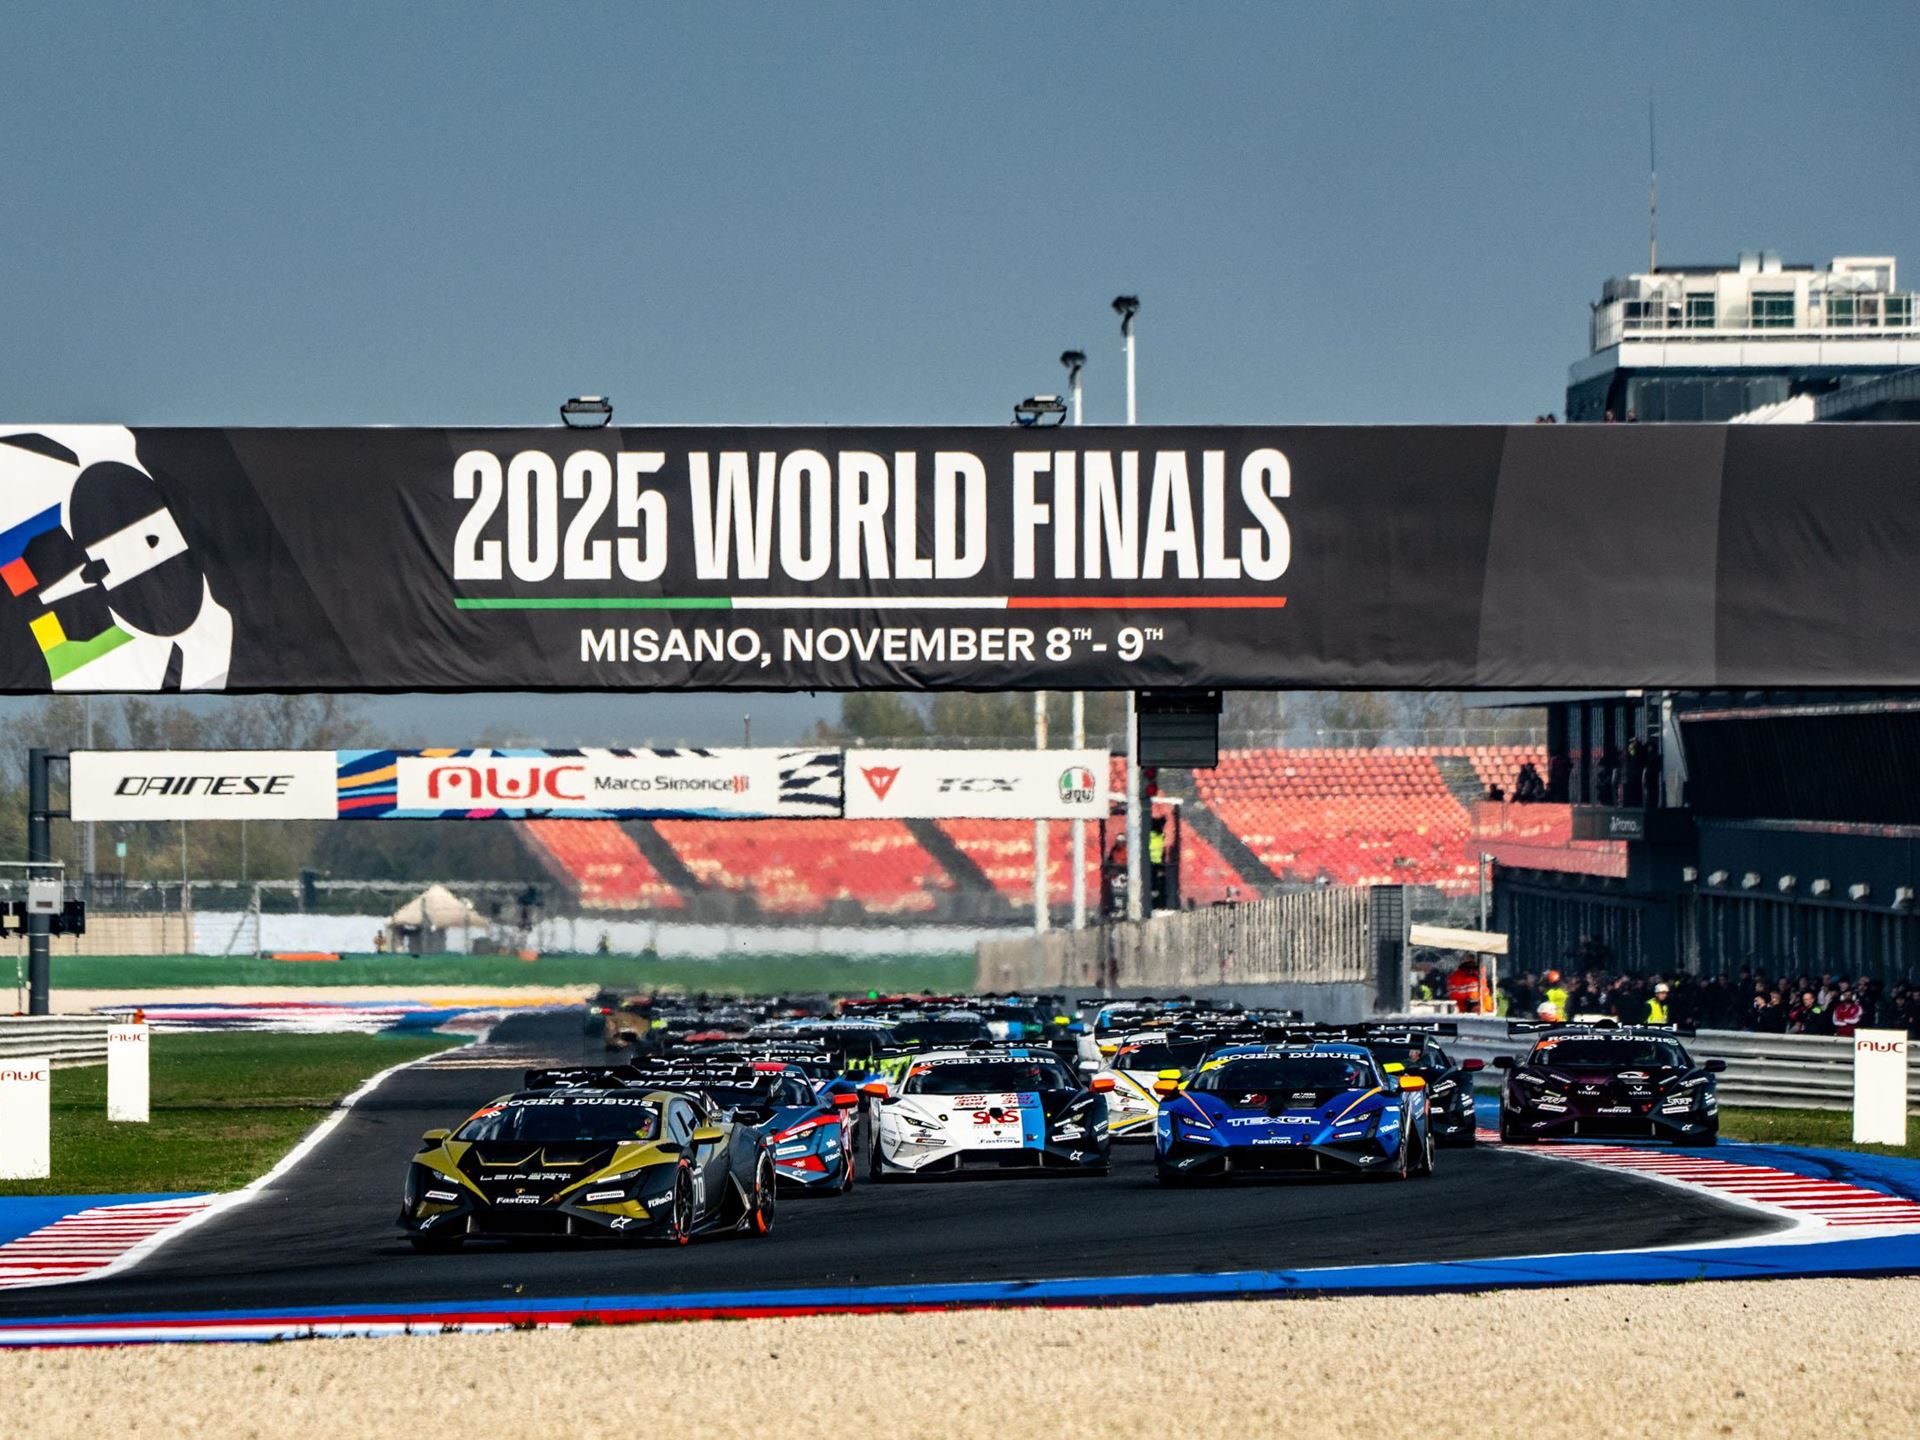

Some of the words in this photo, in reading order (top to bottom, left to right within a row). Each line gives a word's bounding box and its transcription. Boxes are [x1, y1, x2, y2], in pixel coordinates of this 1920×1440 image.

[453, 450, 668, 582] 2025
[688, 449, 987, 581] WORLD
[1013, 448, 1291, 581] FINALS
[580, 628, 772, 668] MISANO,
[784, 627, 1036, 662] NOVEMBER
[1117, 626, 1164, 662] 9TH
[114, 775, 295, 796] DAINESE
[594, 776, 651, 791] Marco
[920, 1058, 982, 1067] ROGER
[988, 1057, 1056, 1065] DUBUIS
[1216, 1053, 1281, 1062] ROGER
[493, 1098, 566, 1108] ROGER
[572, 1098, 654, 1108] DUBUIS
[496, 1197, 540, 1205] Fastron
